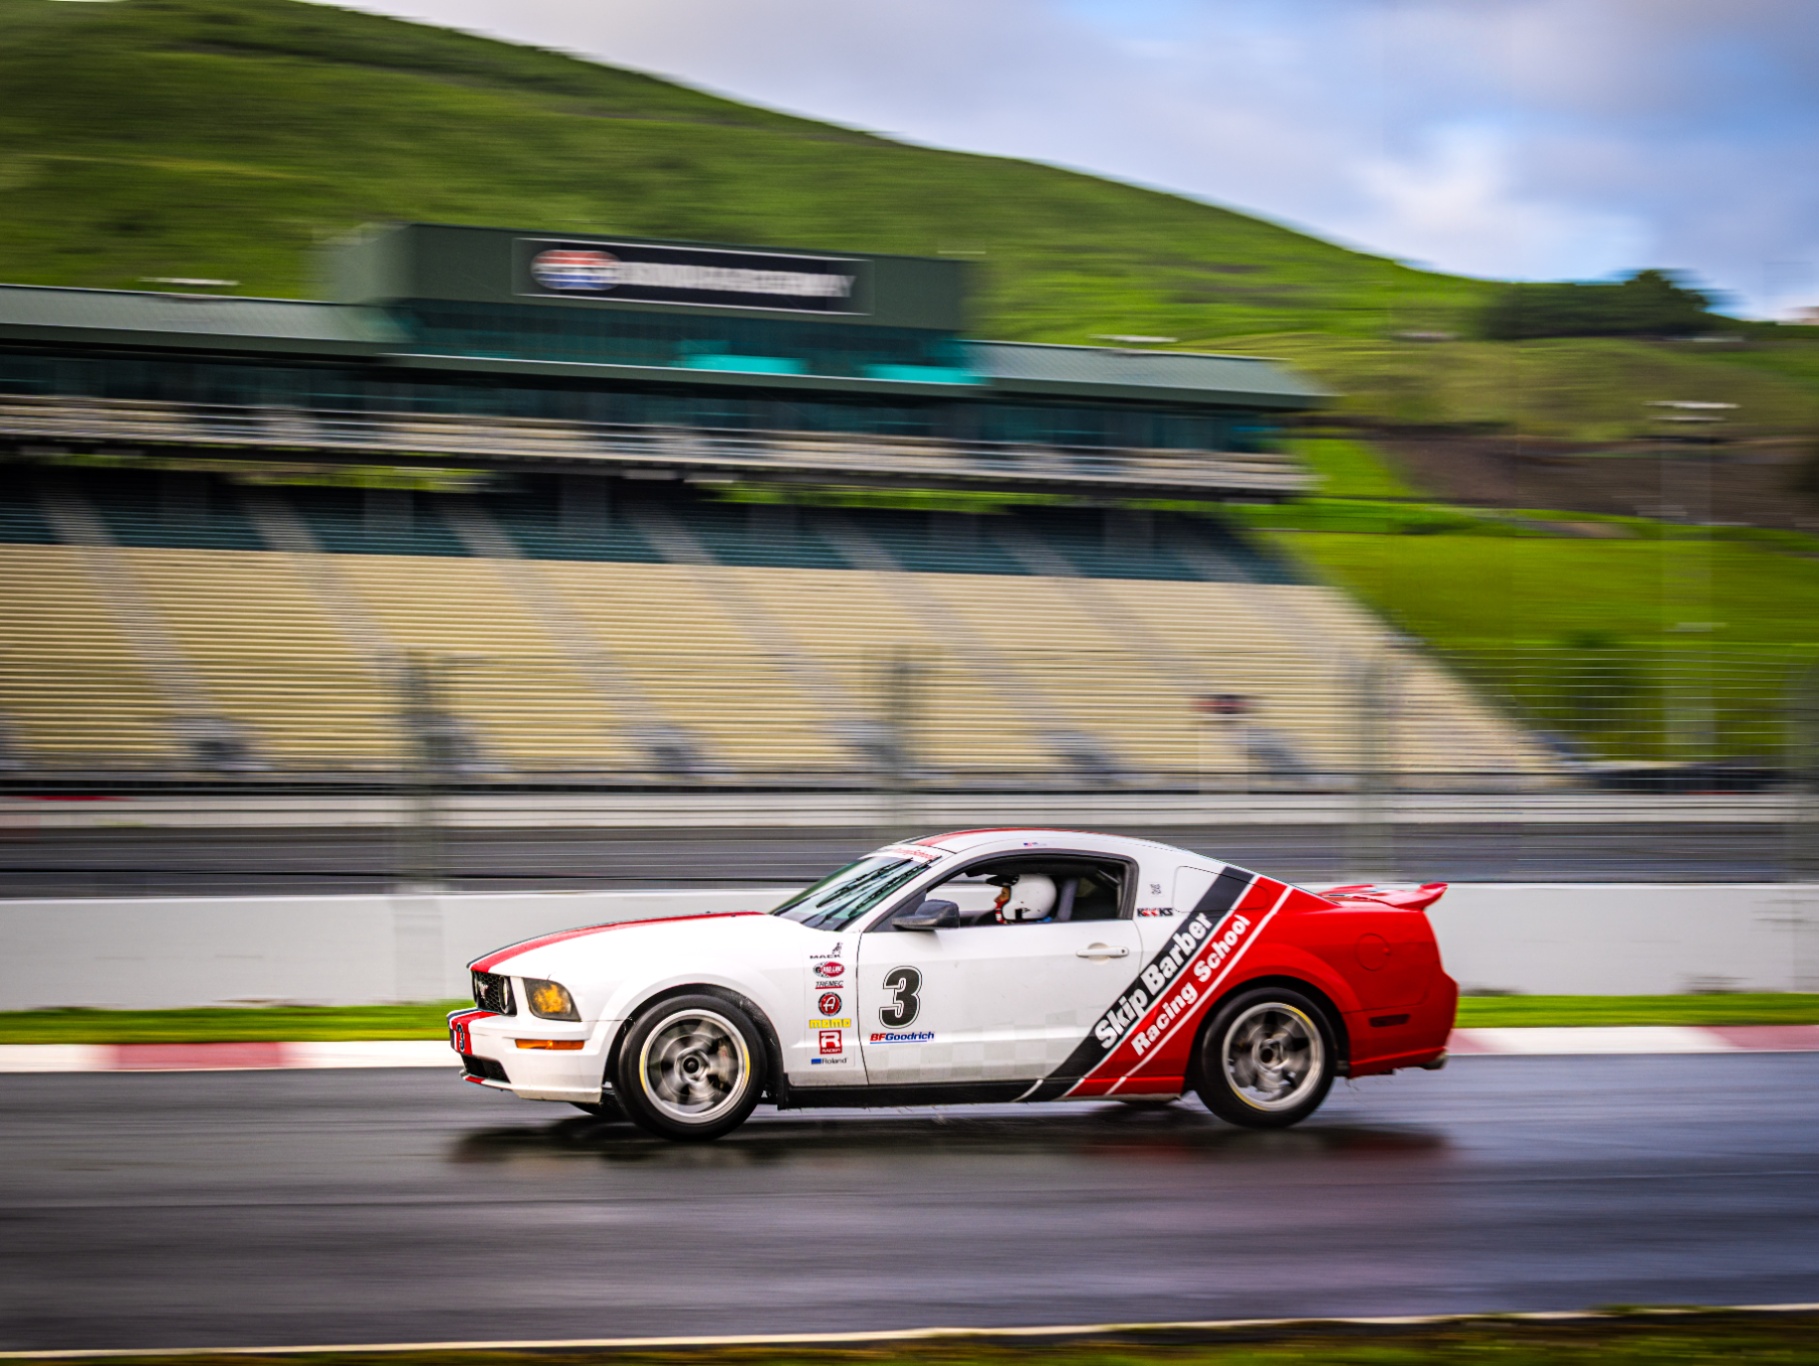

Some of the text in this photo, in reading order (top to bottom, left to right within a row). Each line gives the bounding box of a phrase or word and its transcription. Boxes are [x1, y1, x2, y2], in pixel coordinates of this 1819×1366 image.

[878, 965, 923, 1030] 3
[1094, 912, 1213, 1049] Skip Barber
[1131, 914, 1251, 1056] Racing School
[821, 1032, 840, 1048] R
[870, 1031, 935, 1042] BFGoodrich
